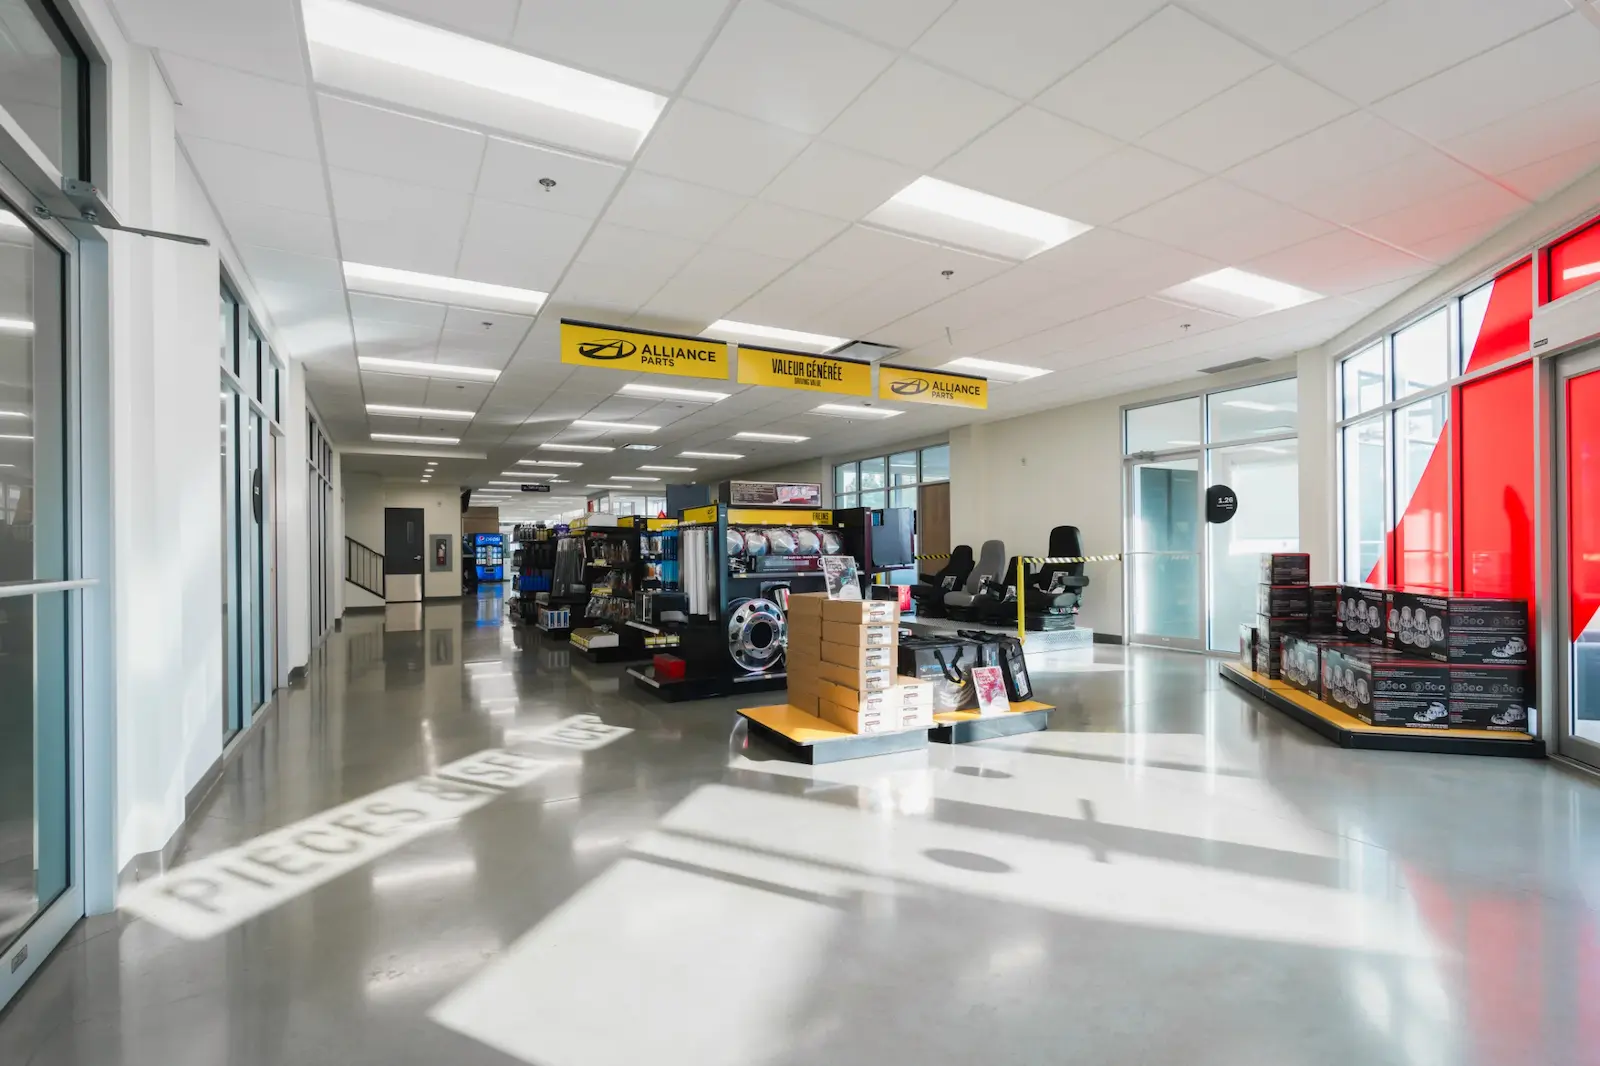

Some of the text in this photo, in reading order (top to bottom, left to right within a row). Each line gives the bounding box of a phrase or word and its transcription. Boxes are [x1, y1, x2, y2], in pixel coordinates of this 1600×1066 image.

[641, 343, 716, 362] ALLIANCE
[641, 355, 675, 367] PARTS
[771, 358, 843, 381] VALEUR GÉNÉRÉE
[931, 391, 954, 400] PARTS
[932, 381, 981, 396] ALLIANCE
